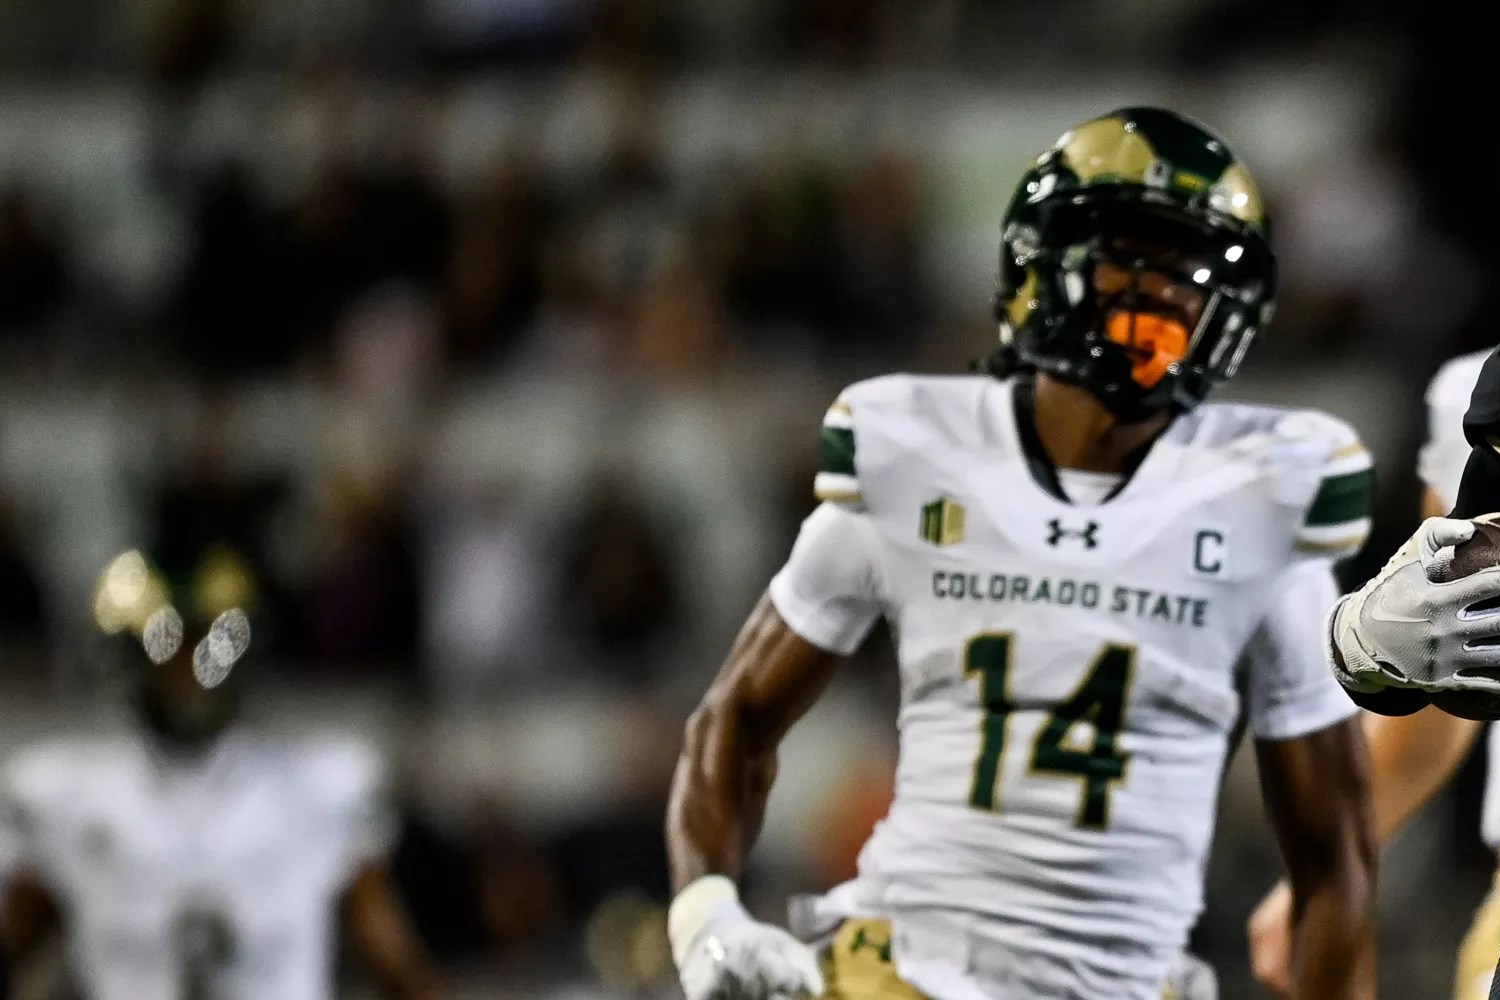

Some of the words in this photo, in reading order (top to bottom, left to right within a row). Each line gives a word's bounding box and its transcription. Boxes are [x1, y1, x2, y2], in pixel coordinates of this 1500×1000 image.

[1194, 530, 1223, 573] C
[932, 570, 1099, 610] COLORADO
[1111, 586, 1208, 627] STATE
[964, 629, 1137, 831] 14
